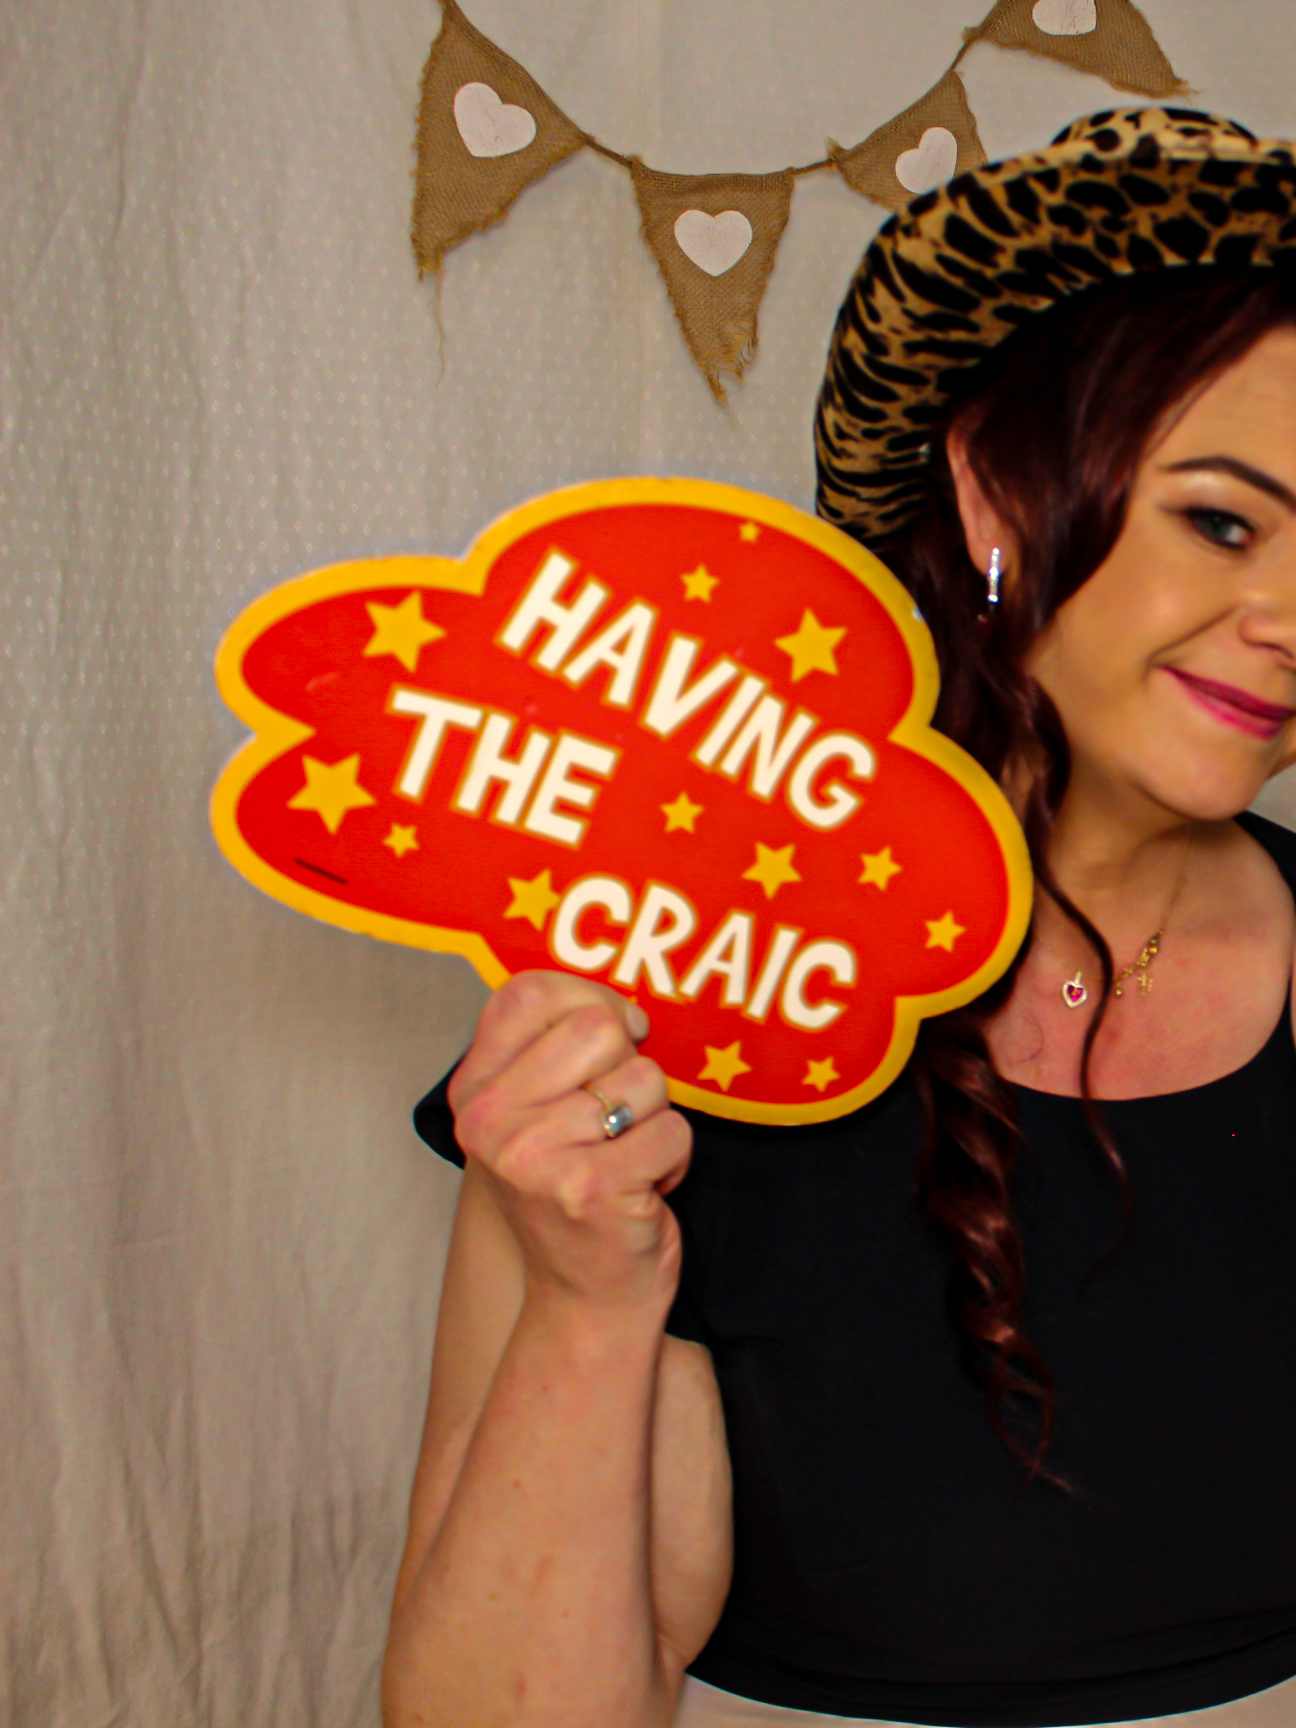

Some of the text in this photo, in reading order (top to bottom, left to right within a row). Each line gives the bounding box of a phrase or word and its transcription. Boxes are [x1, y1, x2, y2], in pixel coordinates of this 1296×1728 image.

[390, 687, 617, 846] THE
[499, 551, 877, 830] HAVING
[551, 876, 857, 1030] CRAIC
